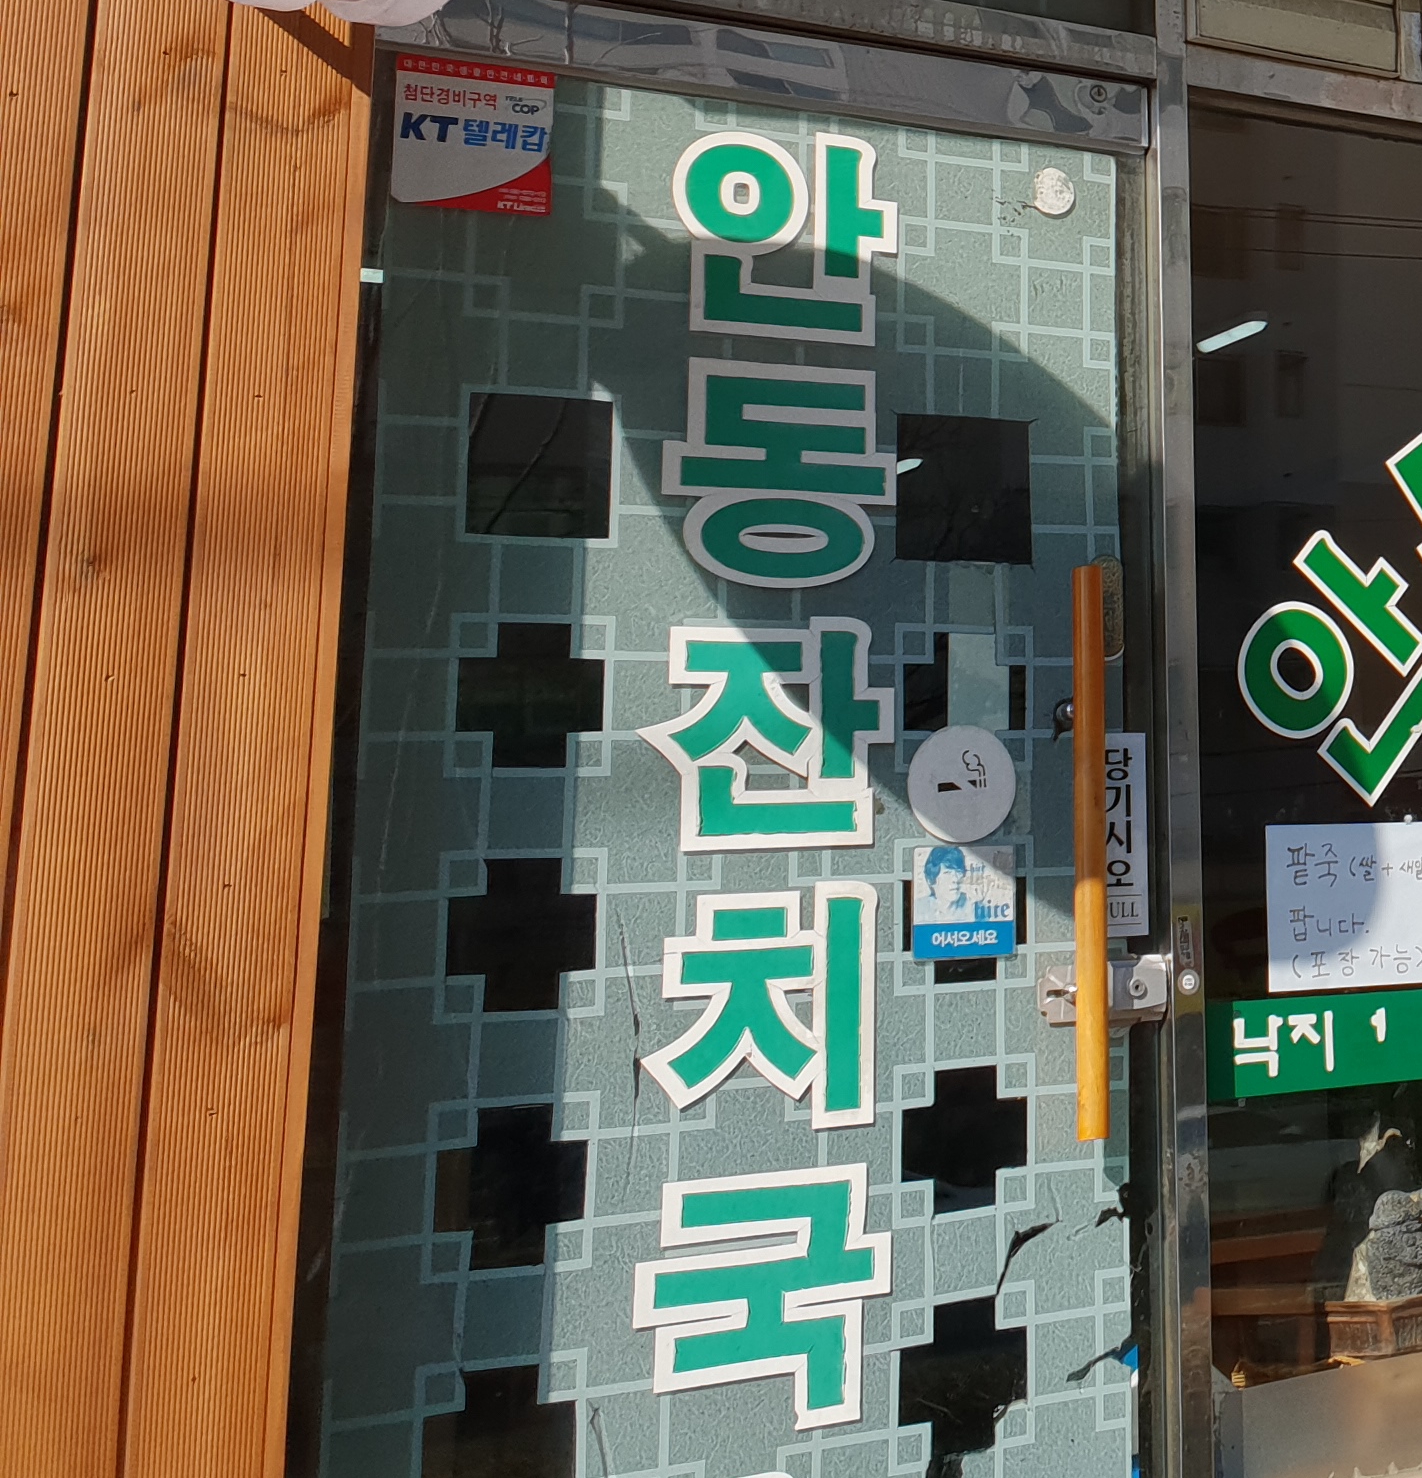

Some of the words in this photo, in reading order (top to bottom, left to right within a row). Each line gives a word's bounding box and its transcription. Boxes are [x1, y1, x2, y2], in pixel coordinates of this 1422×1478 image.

[404, 83, 498, 111] 첨단경비구역
[511, 103, 540, 115] COP
[401, 112, 459, 143] KT
[462, 119, 548, 153] 텔레캅
[632, 130, 898, 1478] 안동잔치국
[1104, 747, 1134, 888] 당기시오
[1286, 842, 1339, 888] 팥죽
[1107, 900, 1139, 919] ULL
[1289, 905, 1370, 942] 팝니다.
[931, 929, 999, 948] 어서오세요
